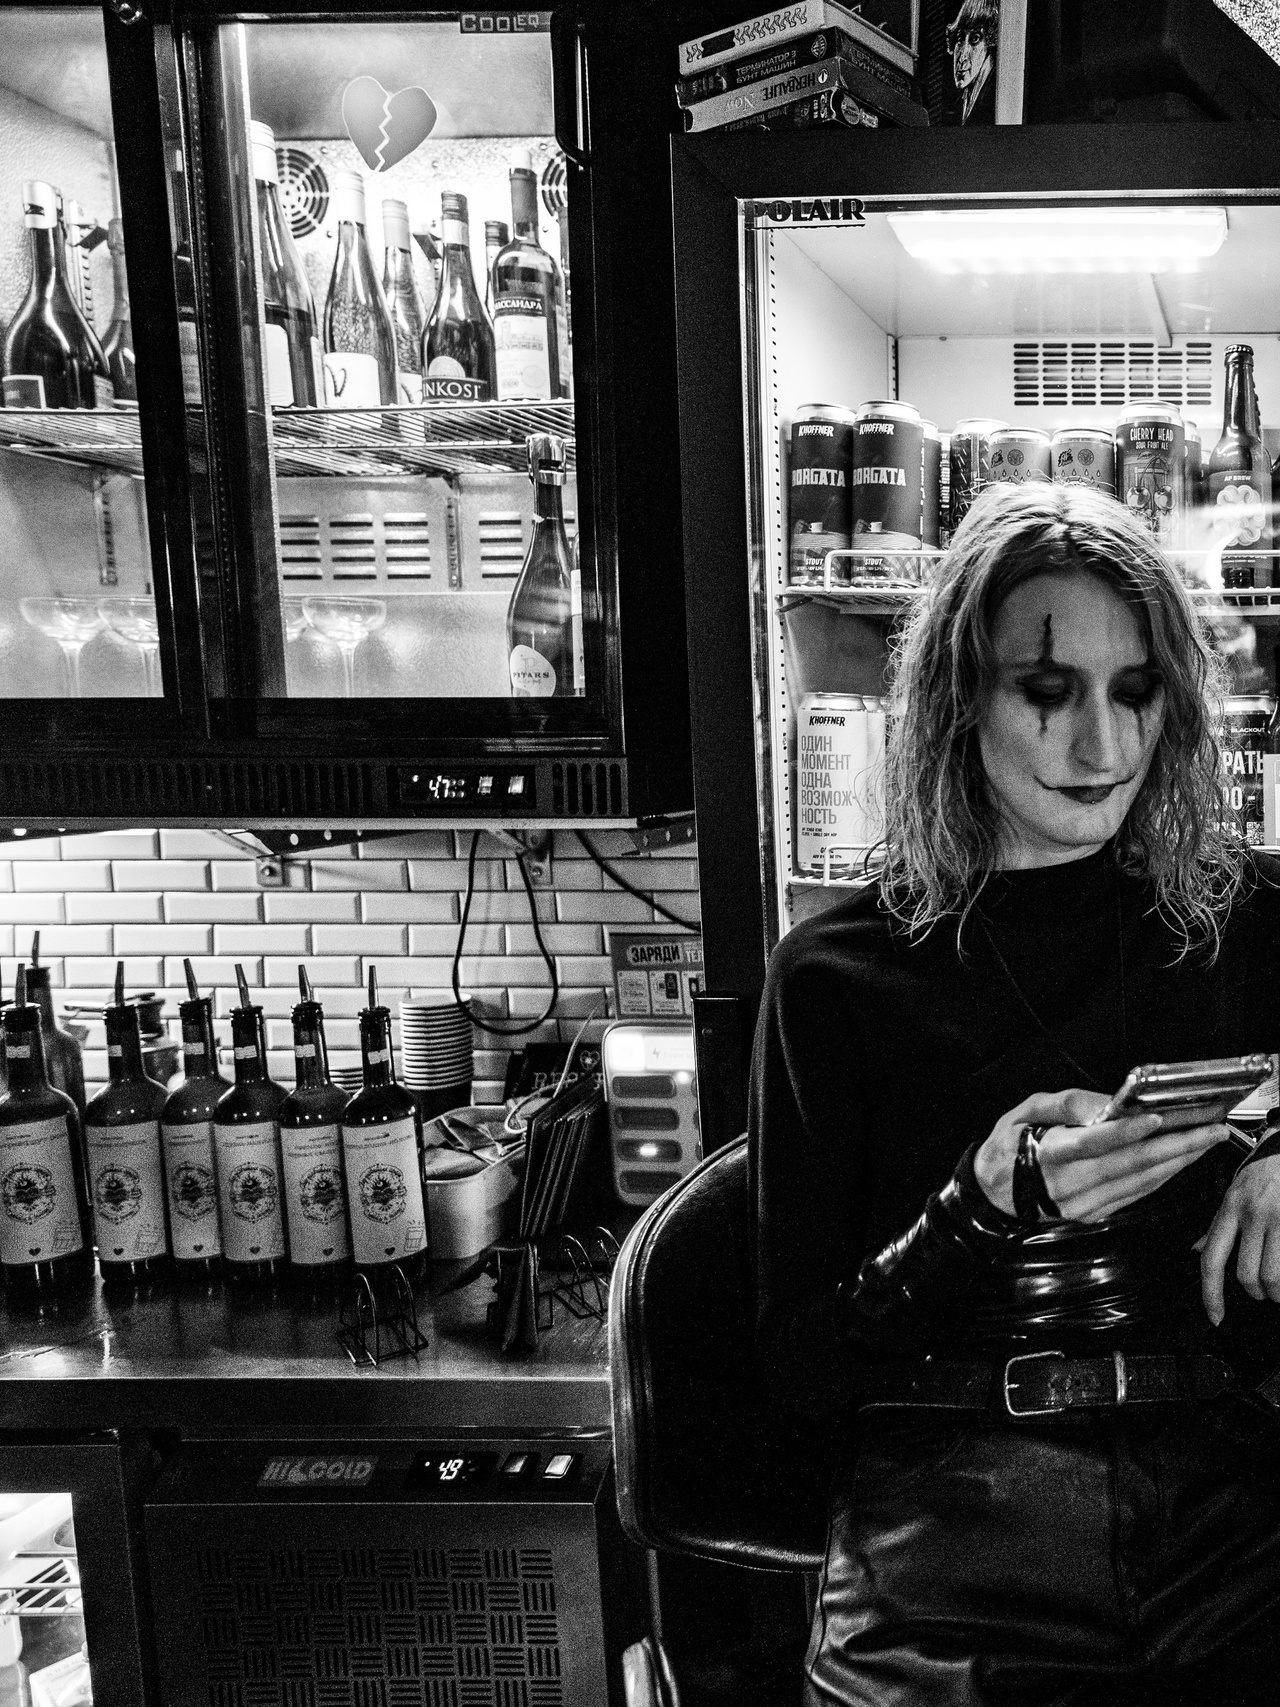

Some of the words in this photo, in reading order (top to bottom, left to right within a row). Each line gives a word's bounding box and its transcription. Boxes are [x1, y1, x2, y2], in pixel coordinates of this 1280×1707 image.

[736, 52, 789, 75] ТЕРМИНАТОР
[737, 71, 759, 84] БУНТ
[761, 60, 796, 76] МАШИН
[762, 72, 816, 100] HERBALIFE
[745, 199, 866, 222] POLAIR
[494, 299, 543, 311] АССАНДРА
[799, 425, 834, 437] KHOFFNER
[859, 423, 894, 435] KHOFFNER
[1130, 427, 1155, 441] CHERRY
[1158, 428, 1174, 442] HEAD
[805, 558, 824, 566] STOUT
[864, 558, 884, 566] STOUT
[809, 716, 846, 726] KHOFFNER
[801, 735, 833, 753] ОДИН
[801, 754, 851, 770] МОМЕНТ
[801, 772, 832, 789] ОДНА
[801, 790, 856, 806] ВОЗМОЖ-
[801, 808, 838, 824] НОСТЬ
[631, 946, 681, 962] ЗАРЯДИ
